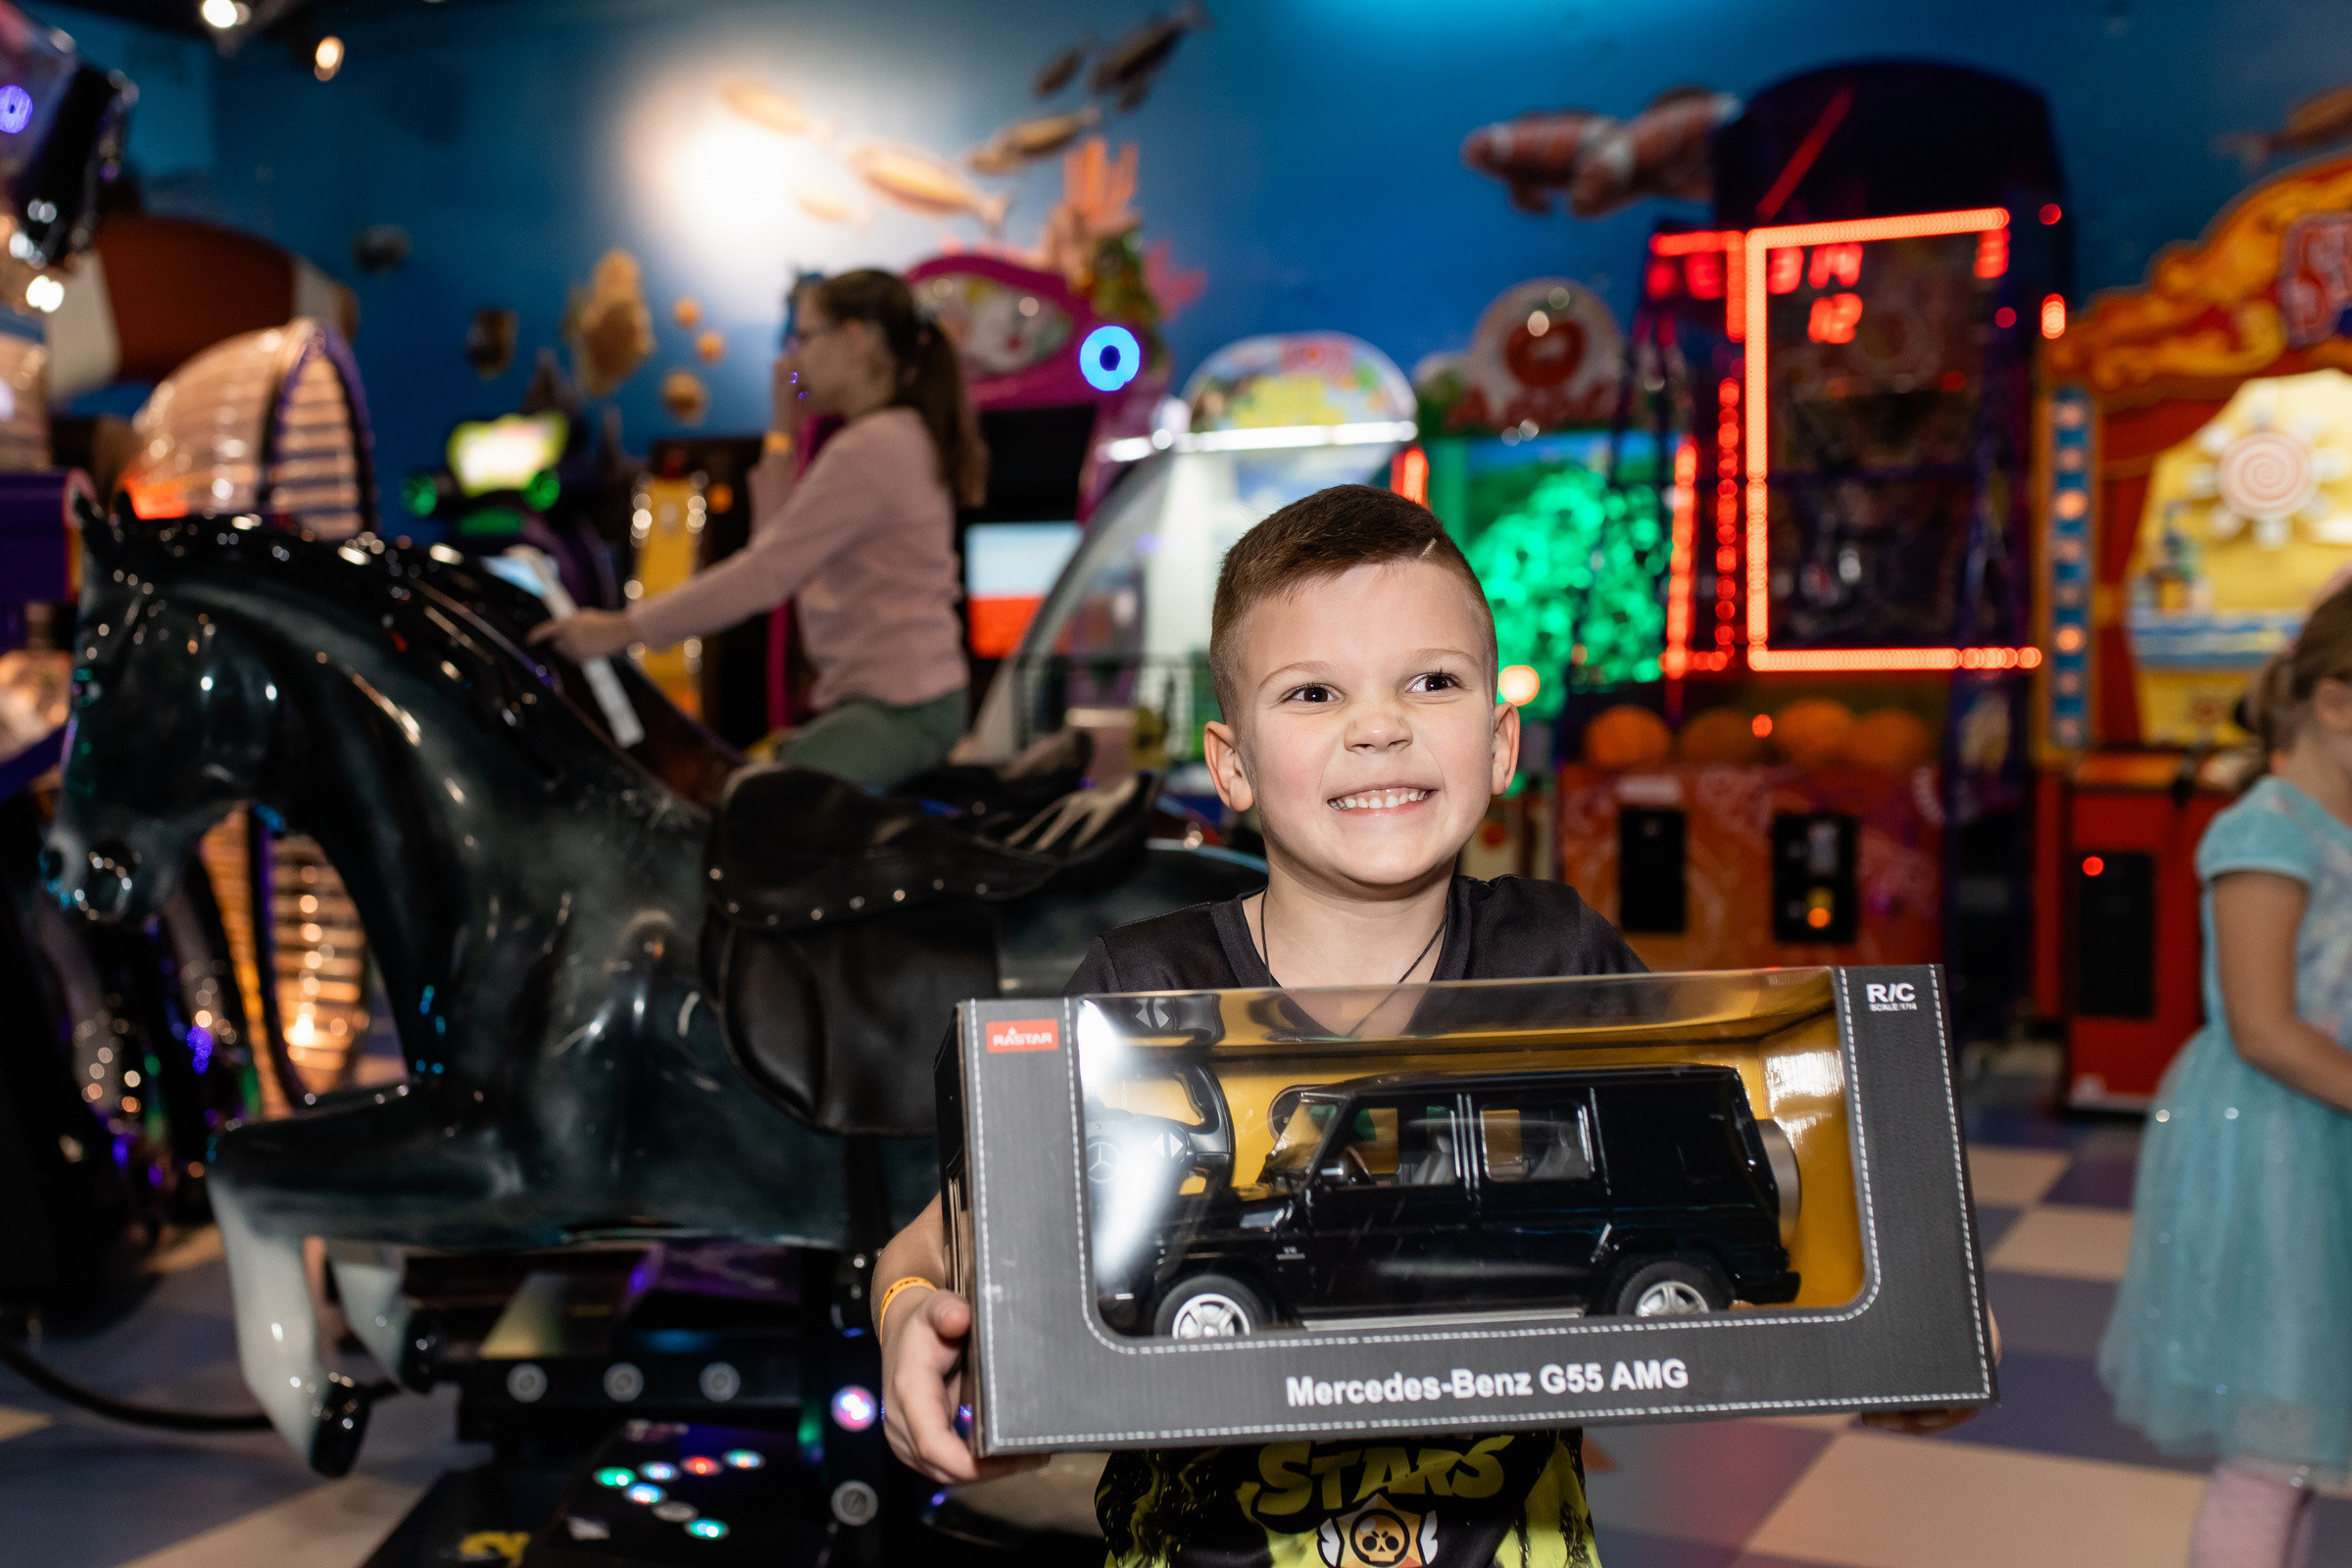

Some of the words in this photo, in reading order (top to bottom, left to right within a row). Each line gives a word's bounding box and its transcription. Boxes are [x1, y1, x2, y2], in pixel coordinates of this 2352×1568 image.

[1866, 983, 1916, 1003] R/C
[993, 1027, 1053, 1047] RASTAR
[1286, 1368, 1534, 1407] Mercedes-Benz
[1539, 1363, 1604, 1395] G55
[1610, 1357, 1689, 1391] AMG
[1257, 1435, 1515, 1516] STARS
